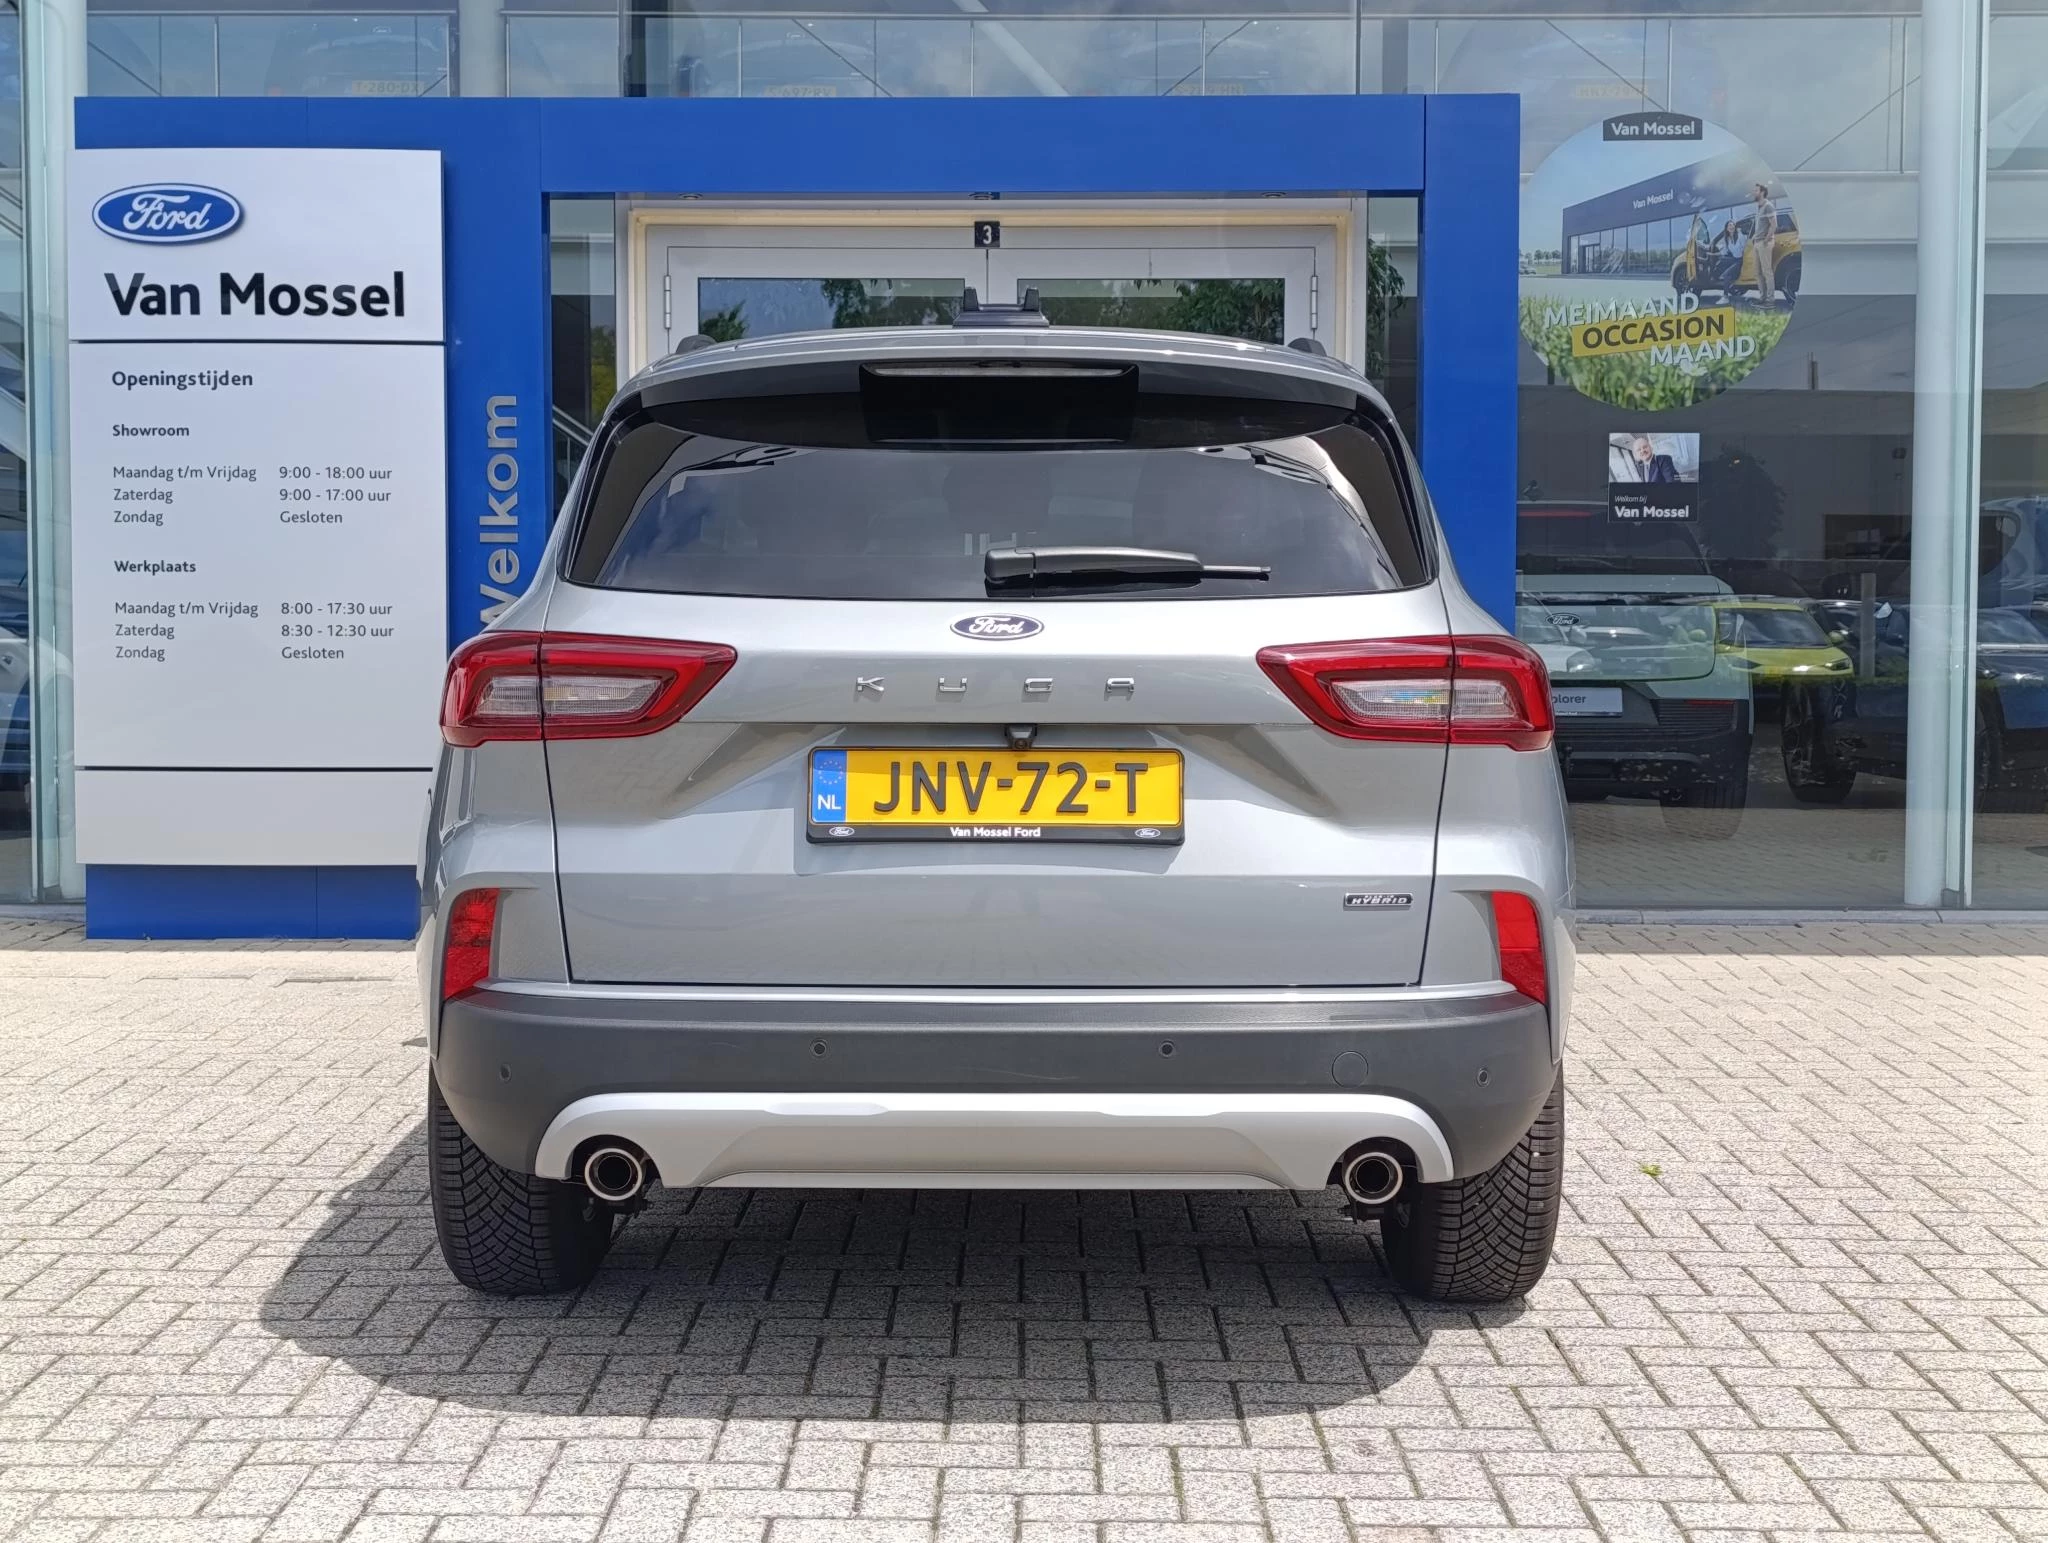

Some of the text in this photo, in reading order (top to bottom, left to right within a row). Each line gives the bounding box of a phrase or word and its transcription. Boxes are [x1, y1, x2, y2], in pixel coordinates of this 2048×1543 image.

[1610, 120, 1695, 136] Van Mossel
[123, 193, 212, 231] Ford
[983, 224, 992, 245] 3
[104, 270, 405, 317] Van Mossel
[1544, 292, 1699, 329] MEIMAAND
[1582, 313, 1724, 349] OCCASION
[1650, 335, 1756, 366] MAAND
[111, 370, 253, 391] Openingstijden
[112, 424, 190, 437] Showroom
[113, 465, 257, 482] Maandag t/m Vrijdag
[279, 466, 311, 480] 9:00
[326, 466, 365, 480] 18:00
[369, 469, 393, 480] uur
[113, 488, 173, 504] Zaterdag
[279, 488, 312, 502] 9:00
[326, 488, 364, 502] 17:00
[367, 491, 392, 502] uur
[113, 510, 164, 526] Zondag
[279, 510, 343, 524] Gesloten
[1615, 504, 1690, 518] Van Mossel
[114, 560, 197, 575] Werkplaats
[114, 601, 259, 617] Maandag t/m Vrijdag
[281, 602, 313, 615] 8:00
[327, 602, 366, 615] 17:30
[369, 604, 393, 615] uur
[968, 614, 1025, 636] Ford
[1552, 615, 1575, 625] Ford
[115, 623, 175, 640] Zaterdag
[281, 624, 313, 638] 8:30
[327, 624, 367, 638] 12:30
[370, 627, 395, 638] uur
[115, 646, 166, 662] Zondag
[281, 646, 345, 660] Gesloten
[856, 676, 1135, 693] KUGA
[873, 761, 1149, 815] JNV-72-T
[817, 794, 842, 811] NL
[950, 826, 1041, 838] Van Mossel Ford
